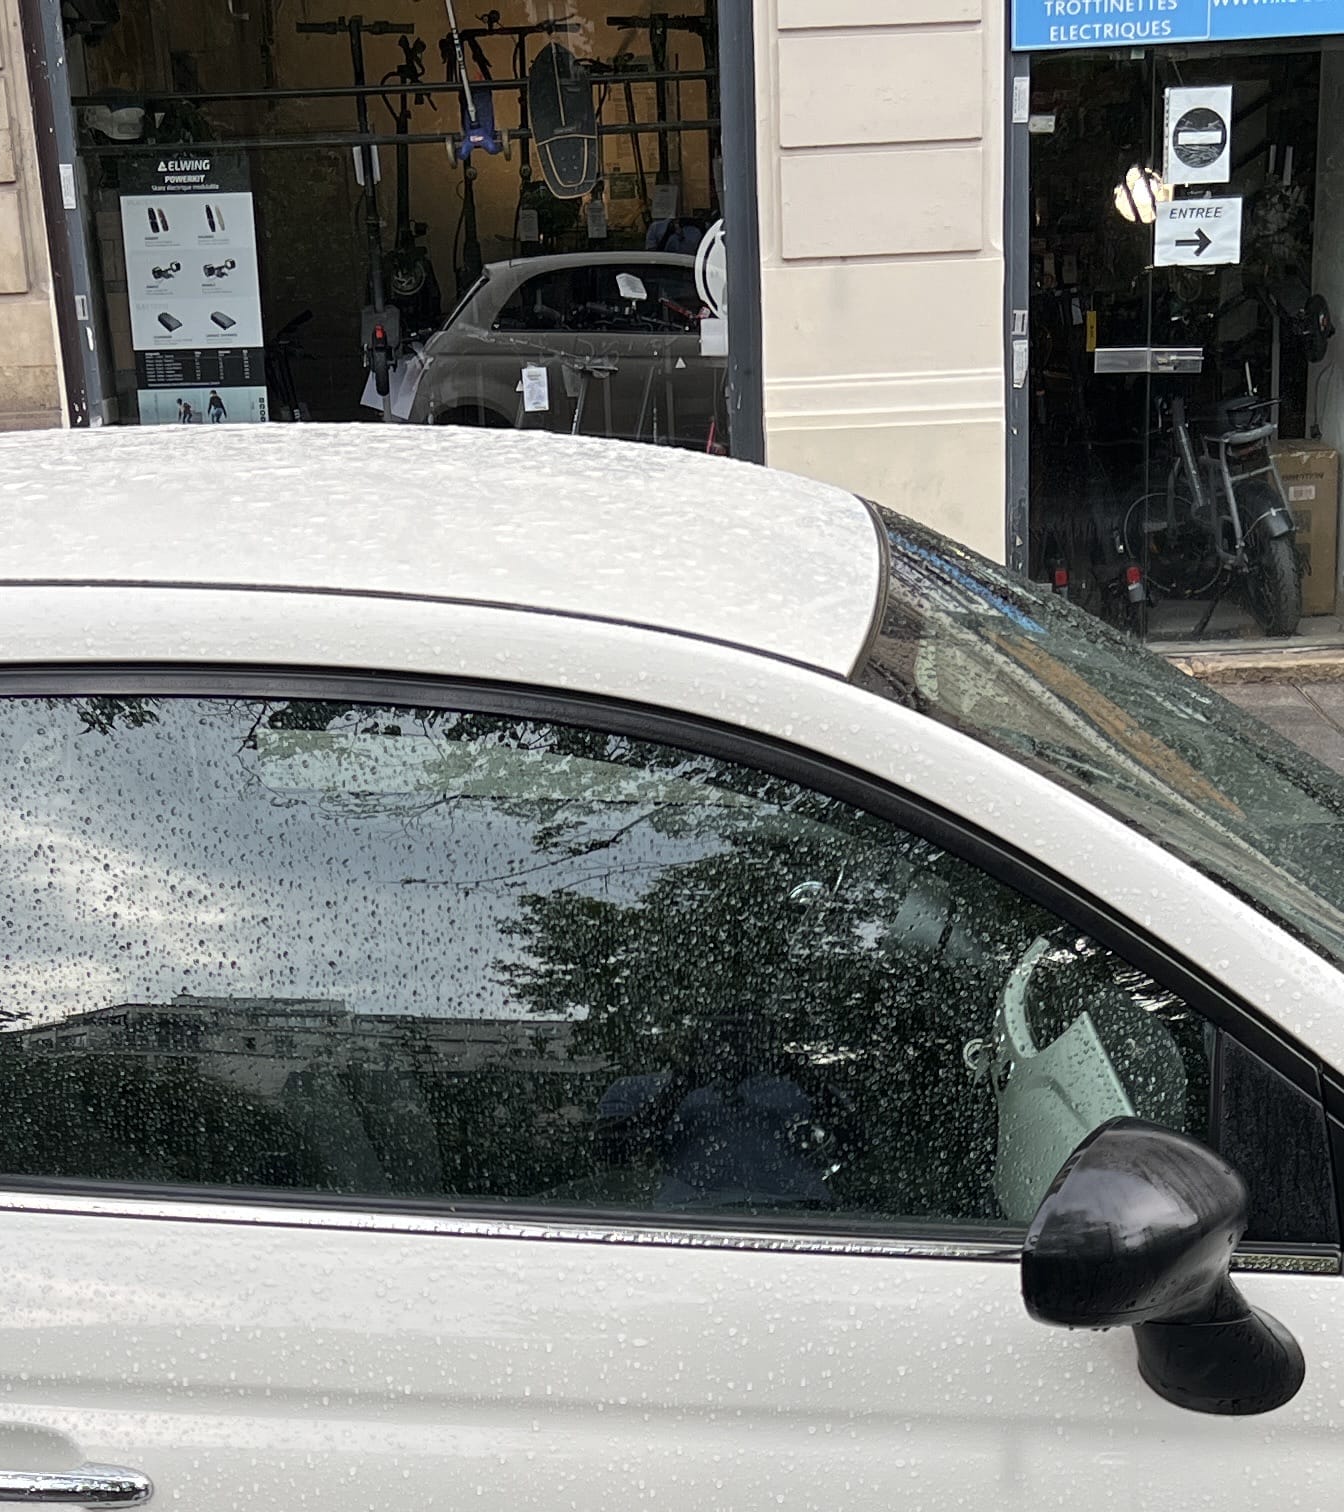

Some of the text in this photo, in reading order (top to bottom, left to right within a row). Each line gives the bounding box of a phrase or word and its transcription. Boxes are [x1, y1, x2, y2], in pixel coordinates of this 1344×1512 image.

[1044, 0, 1178, 17] TROTTINETTES
[1049, 20, 1172, 42] ELECTRIQUES
[167, 159, 211, 172] ELWING
[1169, 207, 1223, 219] ENTREE
